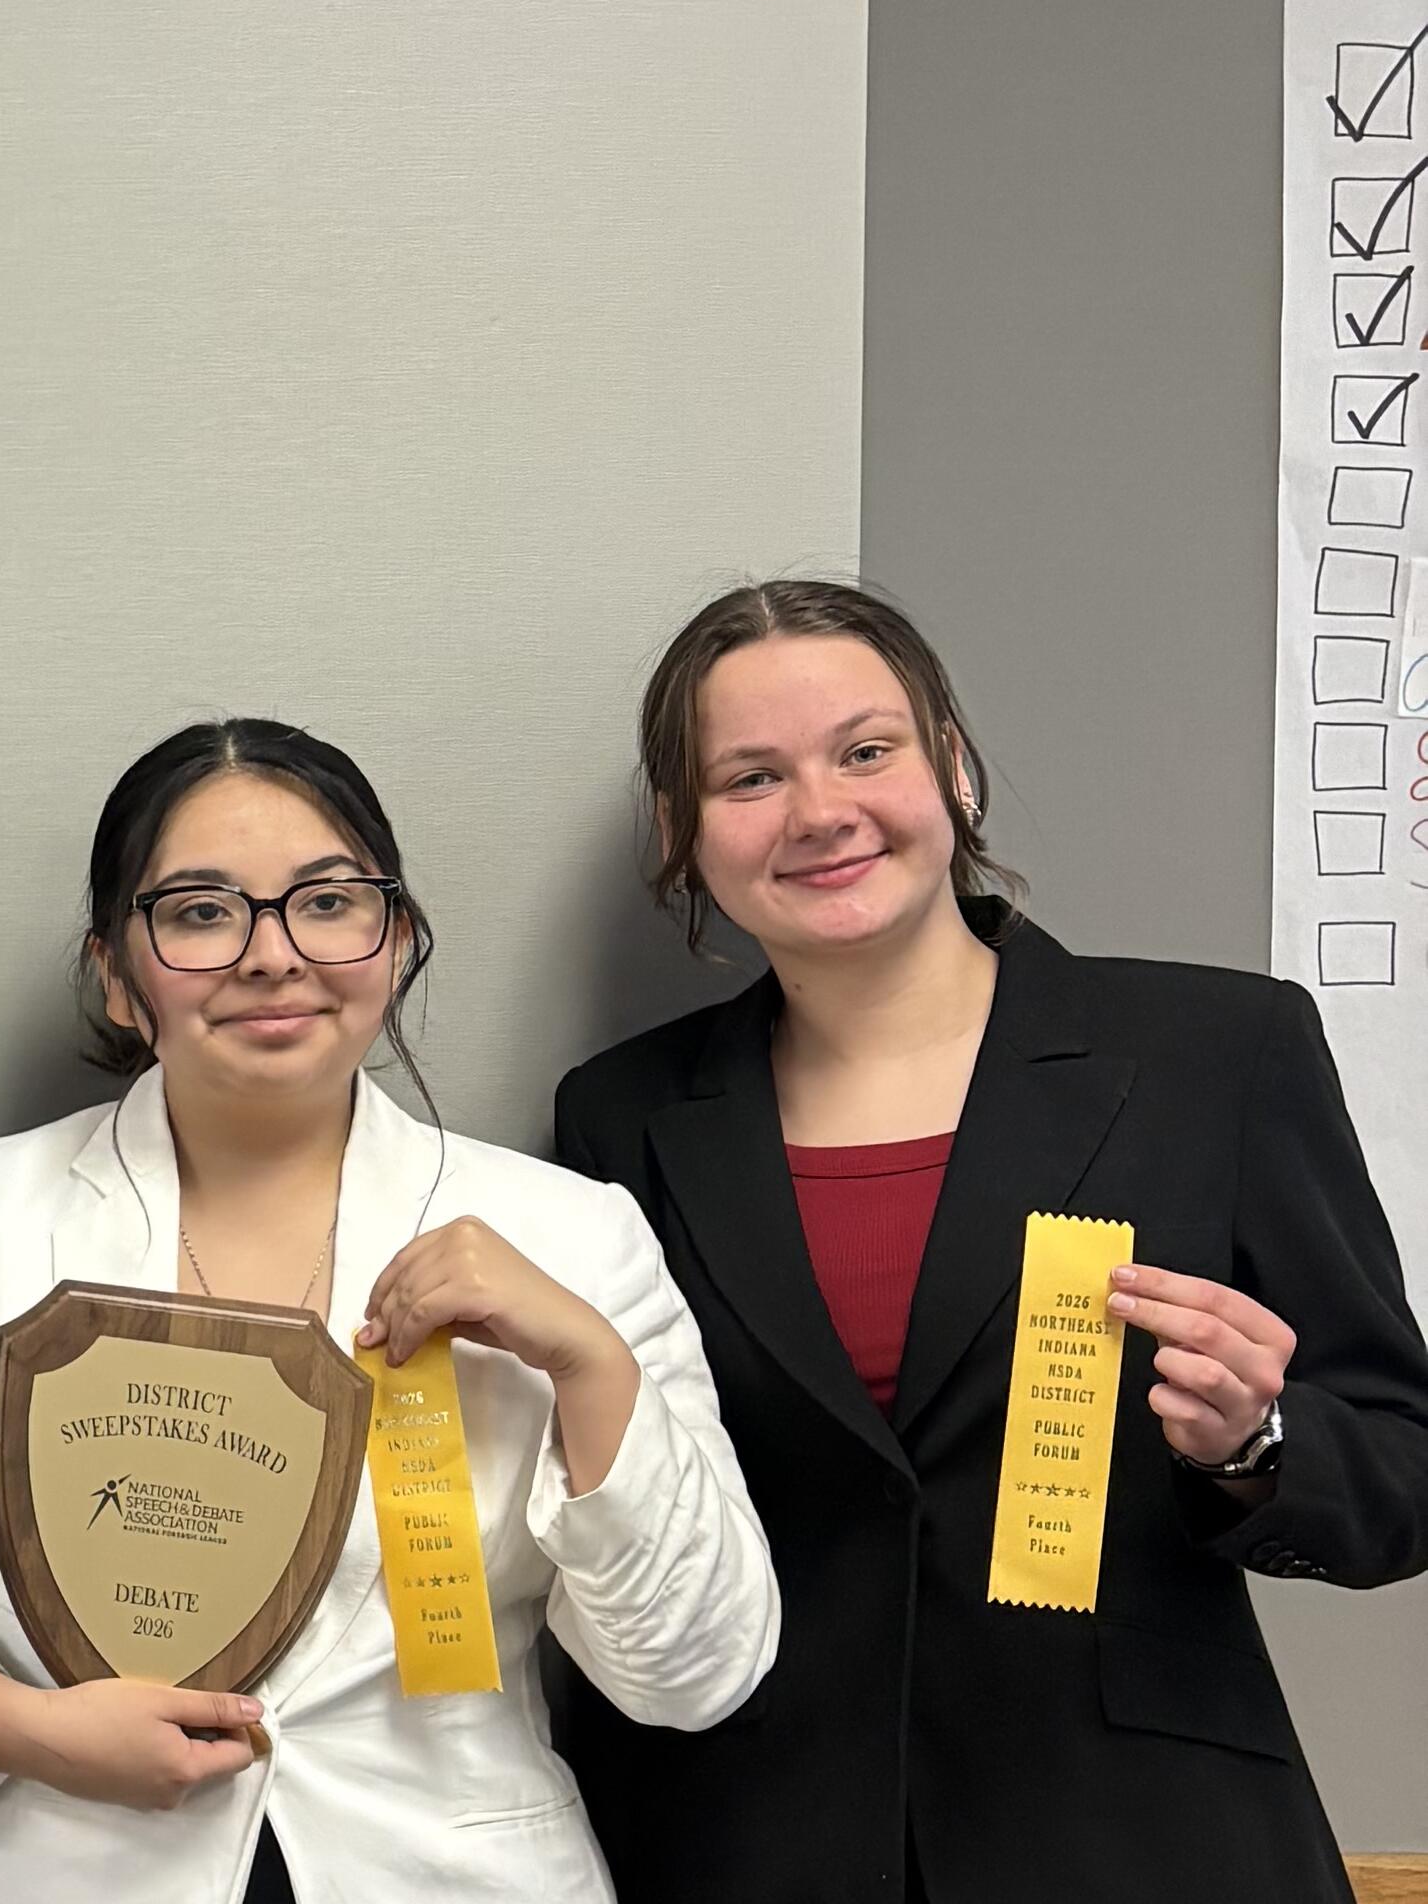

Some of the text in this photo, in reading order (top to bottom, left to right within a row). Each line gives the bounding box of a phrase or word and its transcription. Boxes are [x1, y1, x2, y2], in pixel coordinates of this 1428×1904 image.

[1056, 1293, 1090, 1309] 2026
[1029, 1313, 1111, 1336] NORTHEAST
[1038, 1339, 1097, 1358] INDIANA
[1048, 1364, 1083, 1380] NSDA
[127, 1383, 232, 1417] DISTRICT
[1030, 1385, 1096, 1405] DISTRICT
[1034, 1420, 1085, 1438] PUBLIC
[60, 1415, 288, 1475] SWEEPSTAKES AWARD
[1033, 1443, 1080, 1461] FORUM
[127, 1481, 203, 1503] NATIONAL
[124, 1510, 219, 1535] ASSOCIATION
[404, 1513, 448, 1530] PUBLIC
[1028, 1514, 1072, 1533] Fourth
[409, 1535, 453, 1553] FORUM
[1029, 1539, 1066, 1556] Place
[115, 1583, 200, 1614] DEBATE
[421, 1607, 462, 1621] Fourth
[133, 1615, 174, 1639] 2026
[428, 1630, 463, 1644] Place
